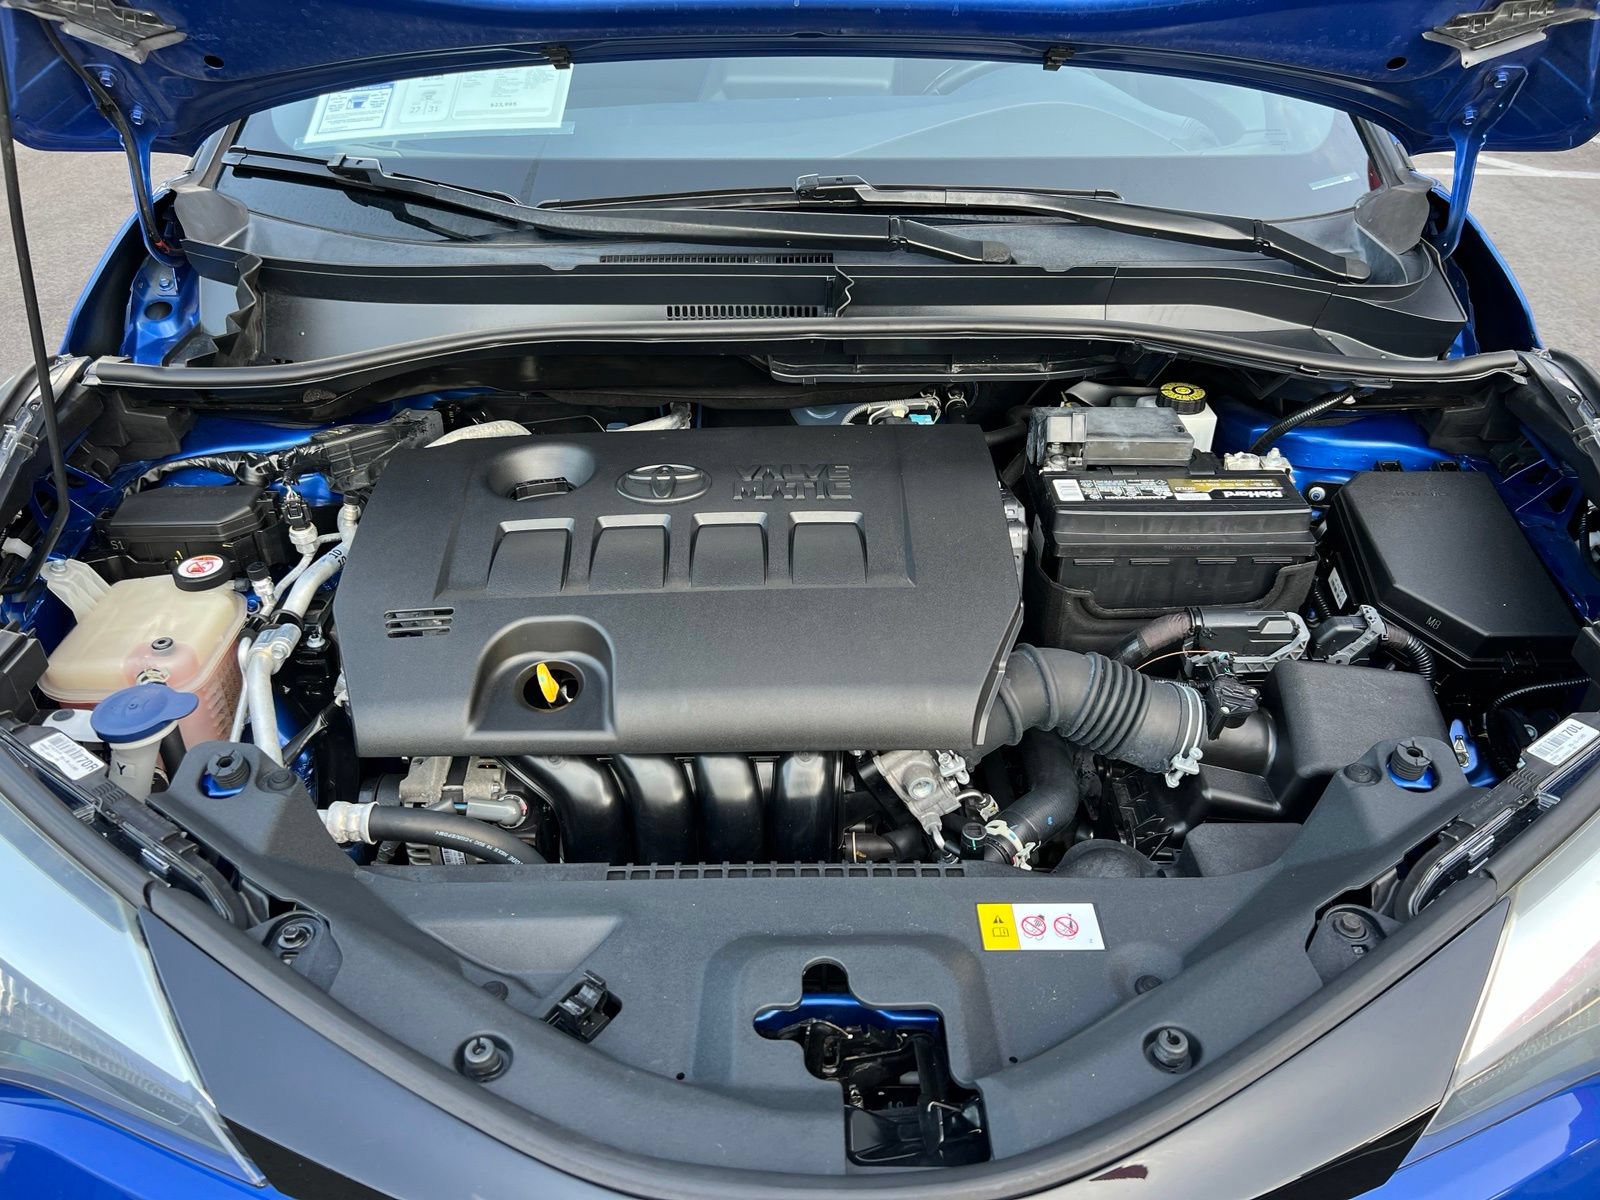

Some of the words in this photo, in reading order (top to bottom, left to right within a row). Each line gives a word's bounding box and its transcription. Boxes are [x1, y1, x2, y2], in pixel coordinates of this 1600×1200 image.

[733, 463, 851, 481] VALVE
[733, 480, 853, 500] MATIC
[1222, 490, 1283, 498] DieHard
[110, 540, 125, 550] S1
[328, 549, 342, 559] 10
[1561, 724, 1584, 737] 70L
[77, 756, 99, 772] 70R
